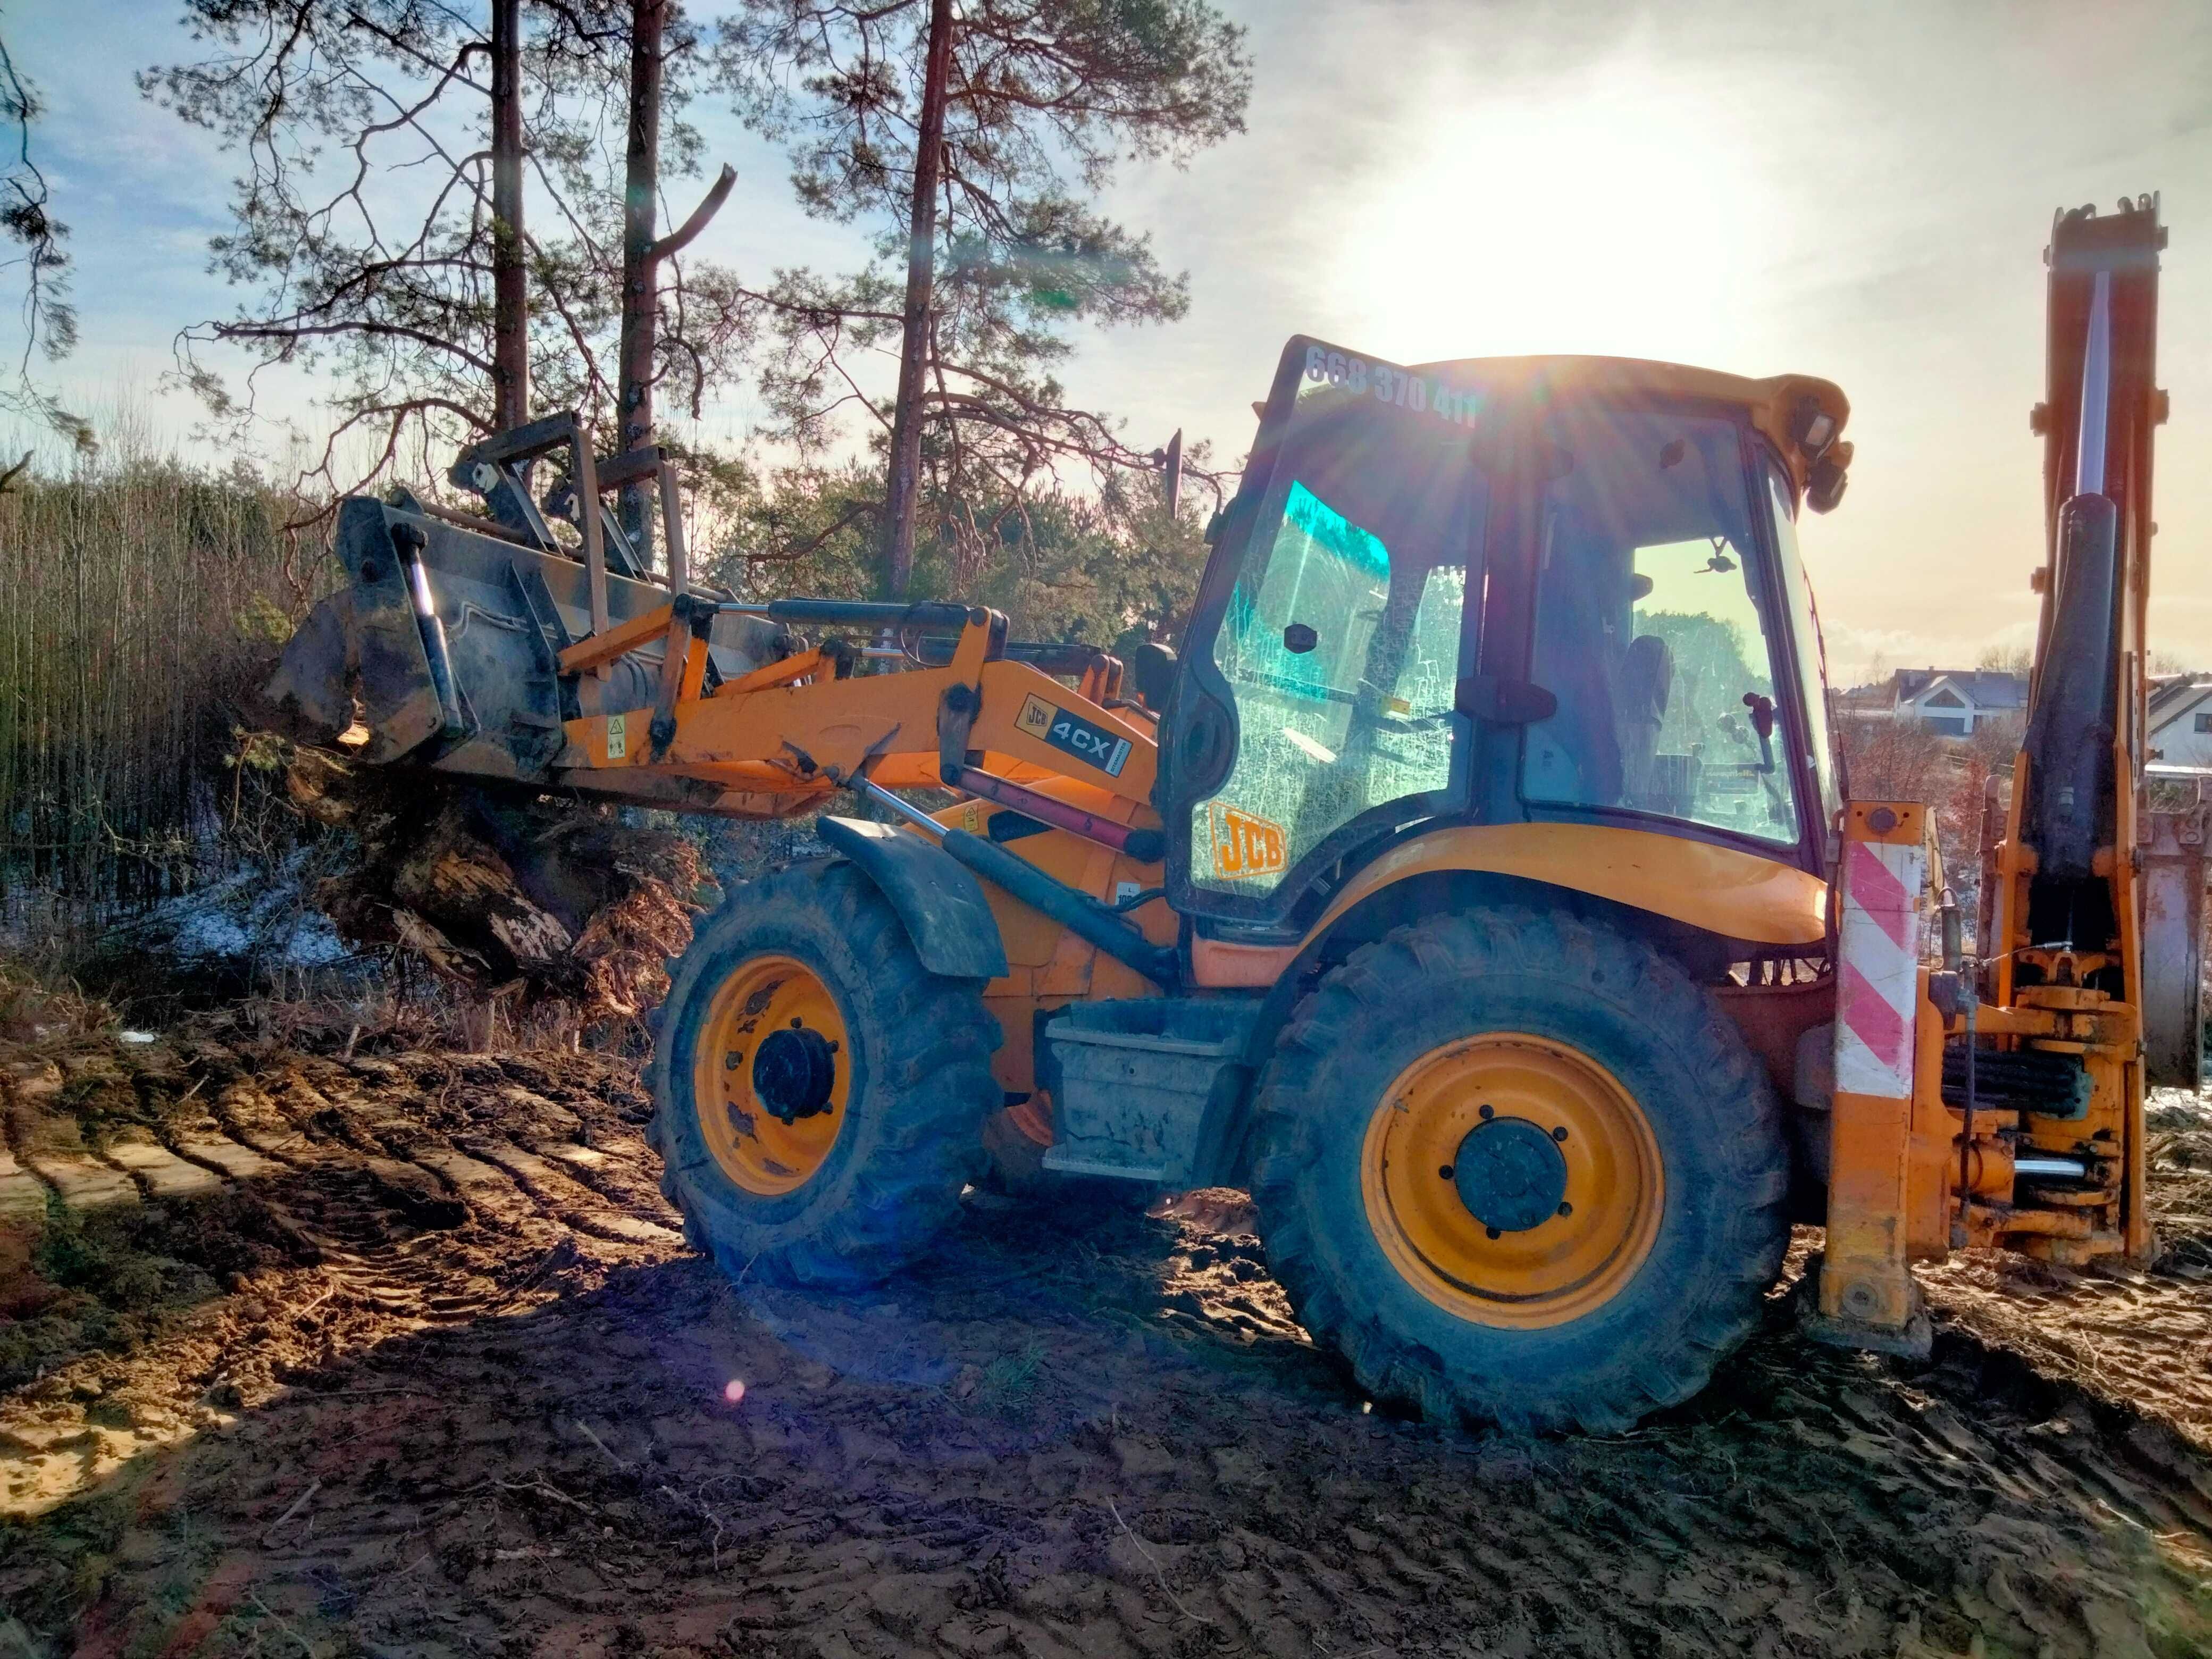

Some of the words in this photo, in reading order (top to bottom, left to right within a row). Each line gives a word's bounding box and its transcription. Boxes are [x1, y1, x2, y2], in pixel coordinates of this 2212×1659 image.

[1306, 346, 1367, 395] 668
[1375, 366, 1427, 412] 370
[1434, 381, 1476, 429] 411
[1028, 706, 1048, 725] JCB
[1053, 722, 1111, 760] 4CX
[1110, 742, 1127, 772] SITEMASTER
[1221, 812, 1281, 872] JCB
